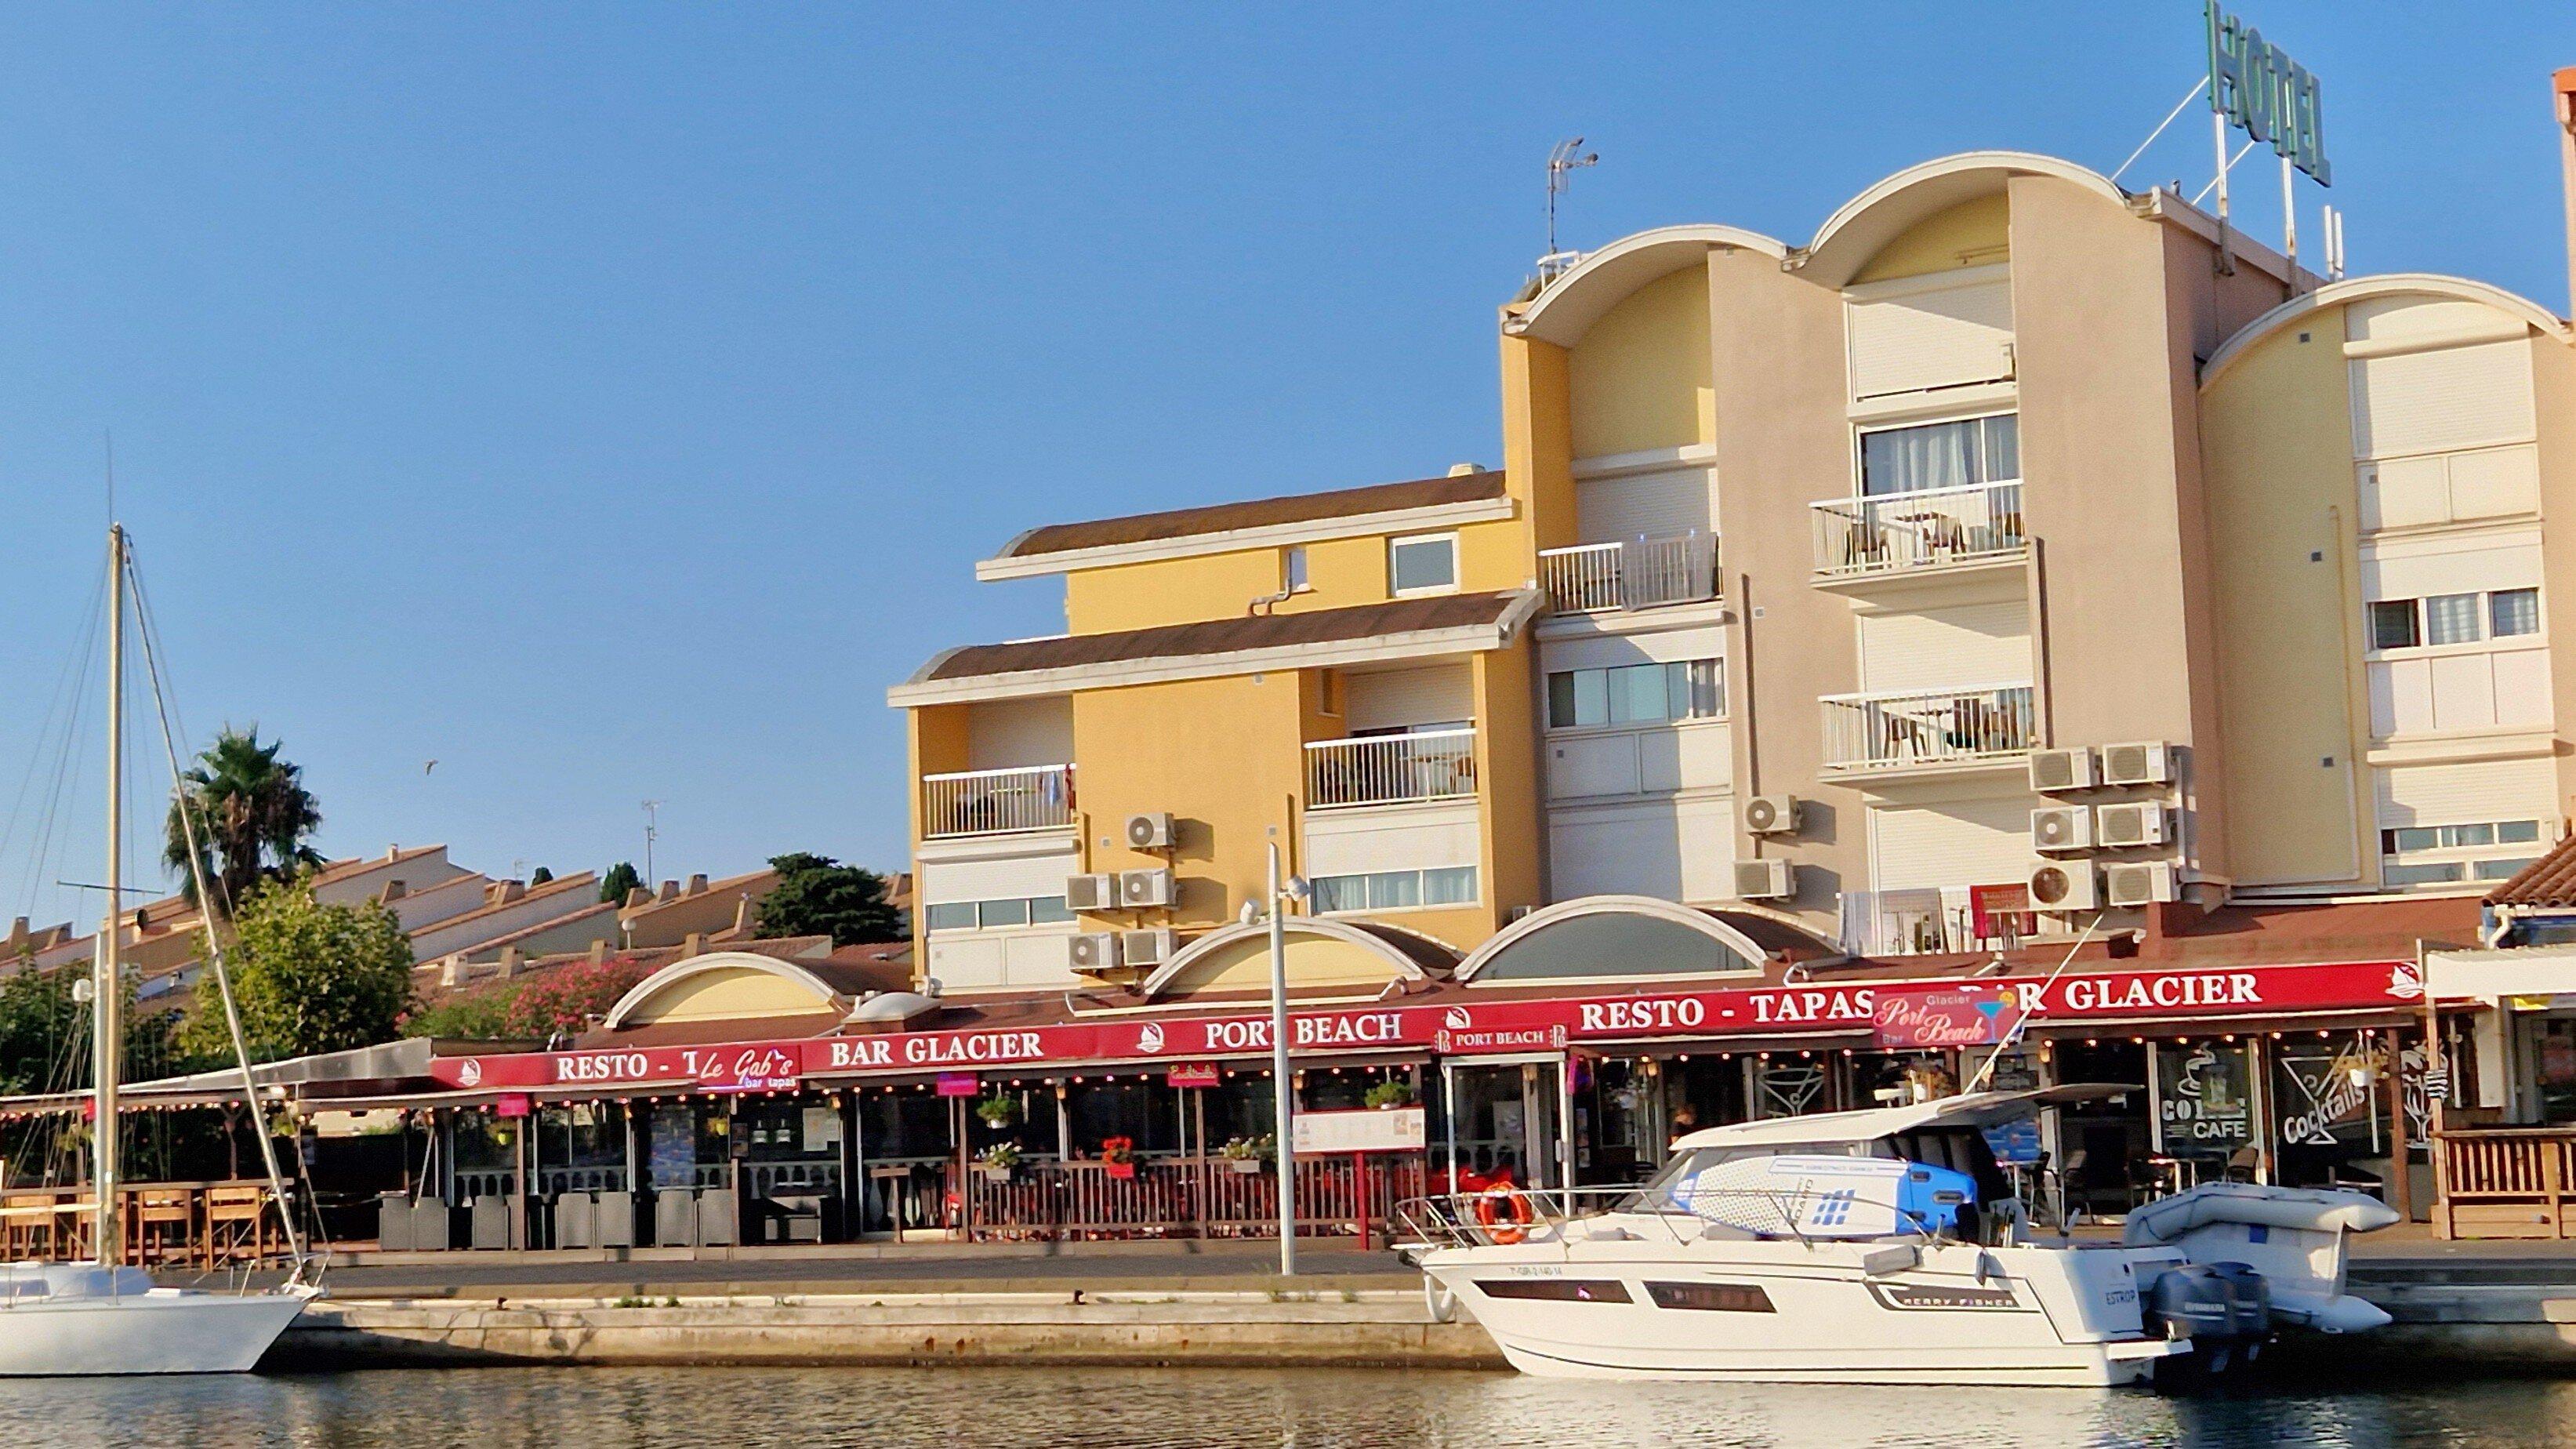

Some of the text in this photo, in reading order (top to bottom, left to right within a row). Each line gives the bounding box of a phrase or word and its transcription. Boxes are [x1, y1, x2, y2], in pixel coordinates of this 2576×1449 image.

[2204, 0, 2331, 188] HOTEL
[1926, 994, 1971, 1006] Glacier
[2064, 973, 2263, 1011] GLACIER
[1579, 997, 1705, 1031] RESTO
[1749, 990, 1876, 1022] TAPAS
[1873, 997, 1928, 1028] Port
[1294, 1013, 1402, 1044] BEACH
[1456, 1032, 1493, 1047] PORT
[1496, 1030, 1544, 1044] BEACH
[1914, 1013, 1986, 1044] Beach
[701, 1052, 725, 1079] Le
[831, 1033, 1045, 1067] BAR GLACIER
[557, 1053, 648, 1081] RESTO
[2284, 1079, 2366, 1144] Cocktails
[2193, 1120, 2248, 1138] CAFE
